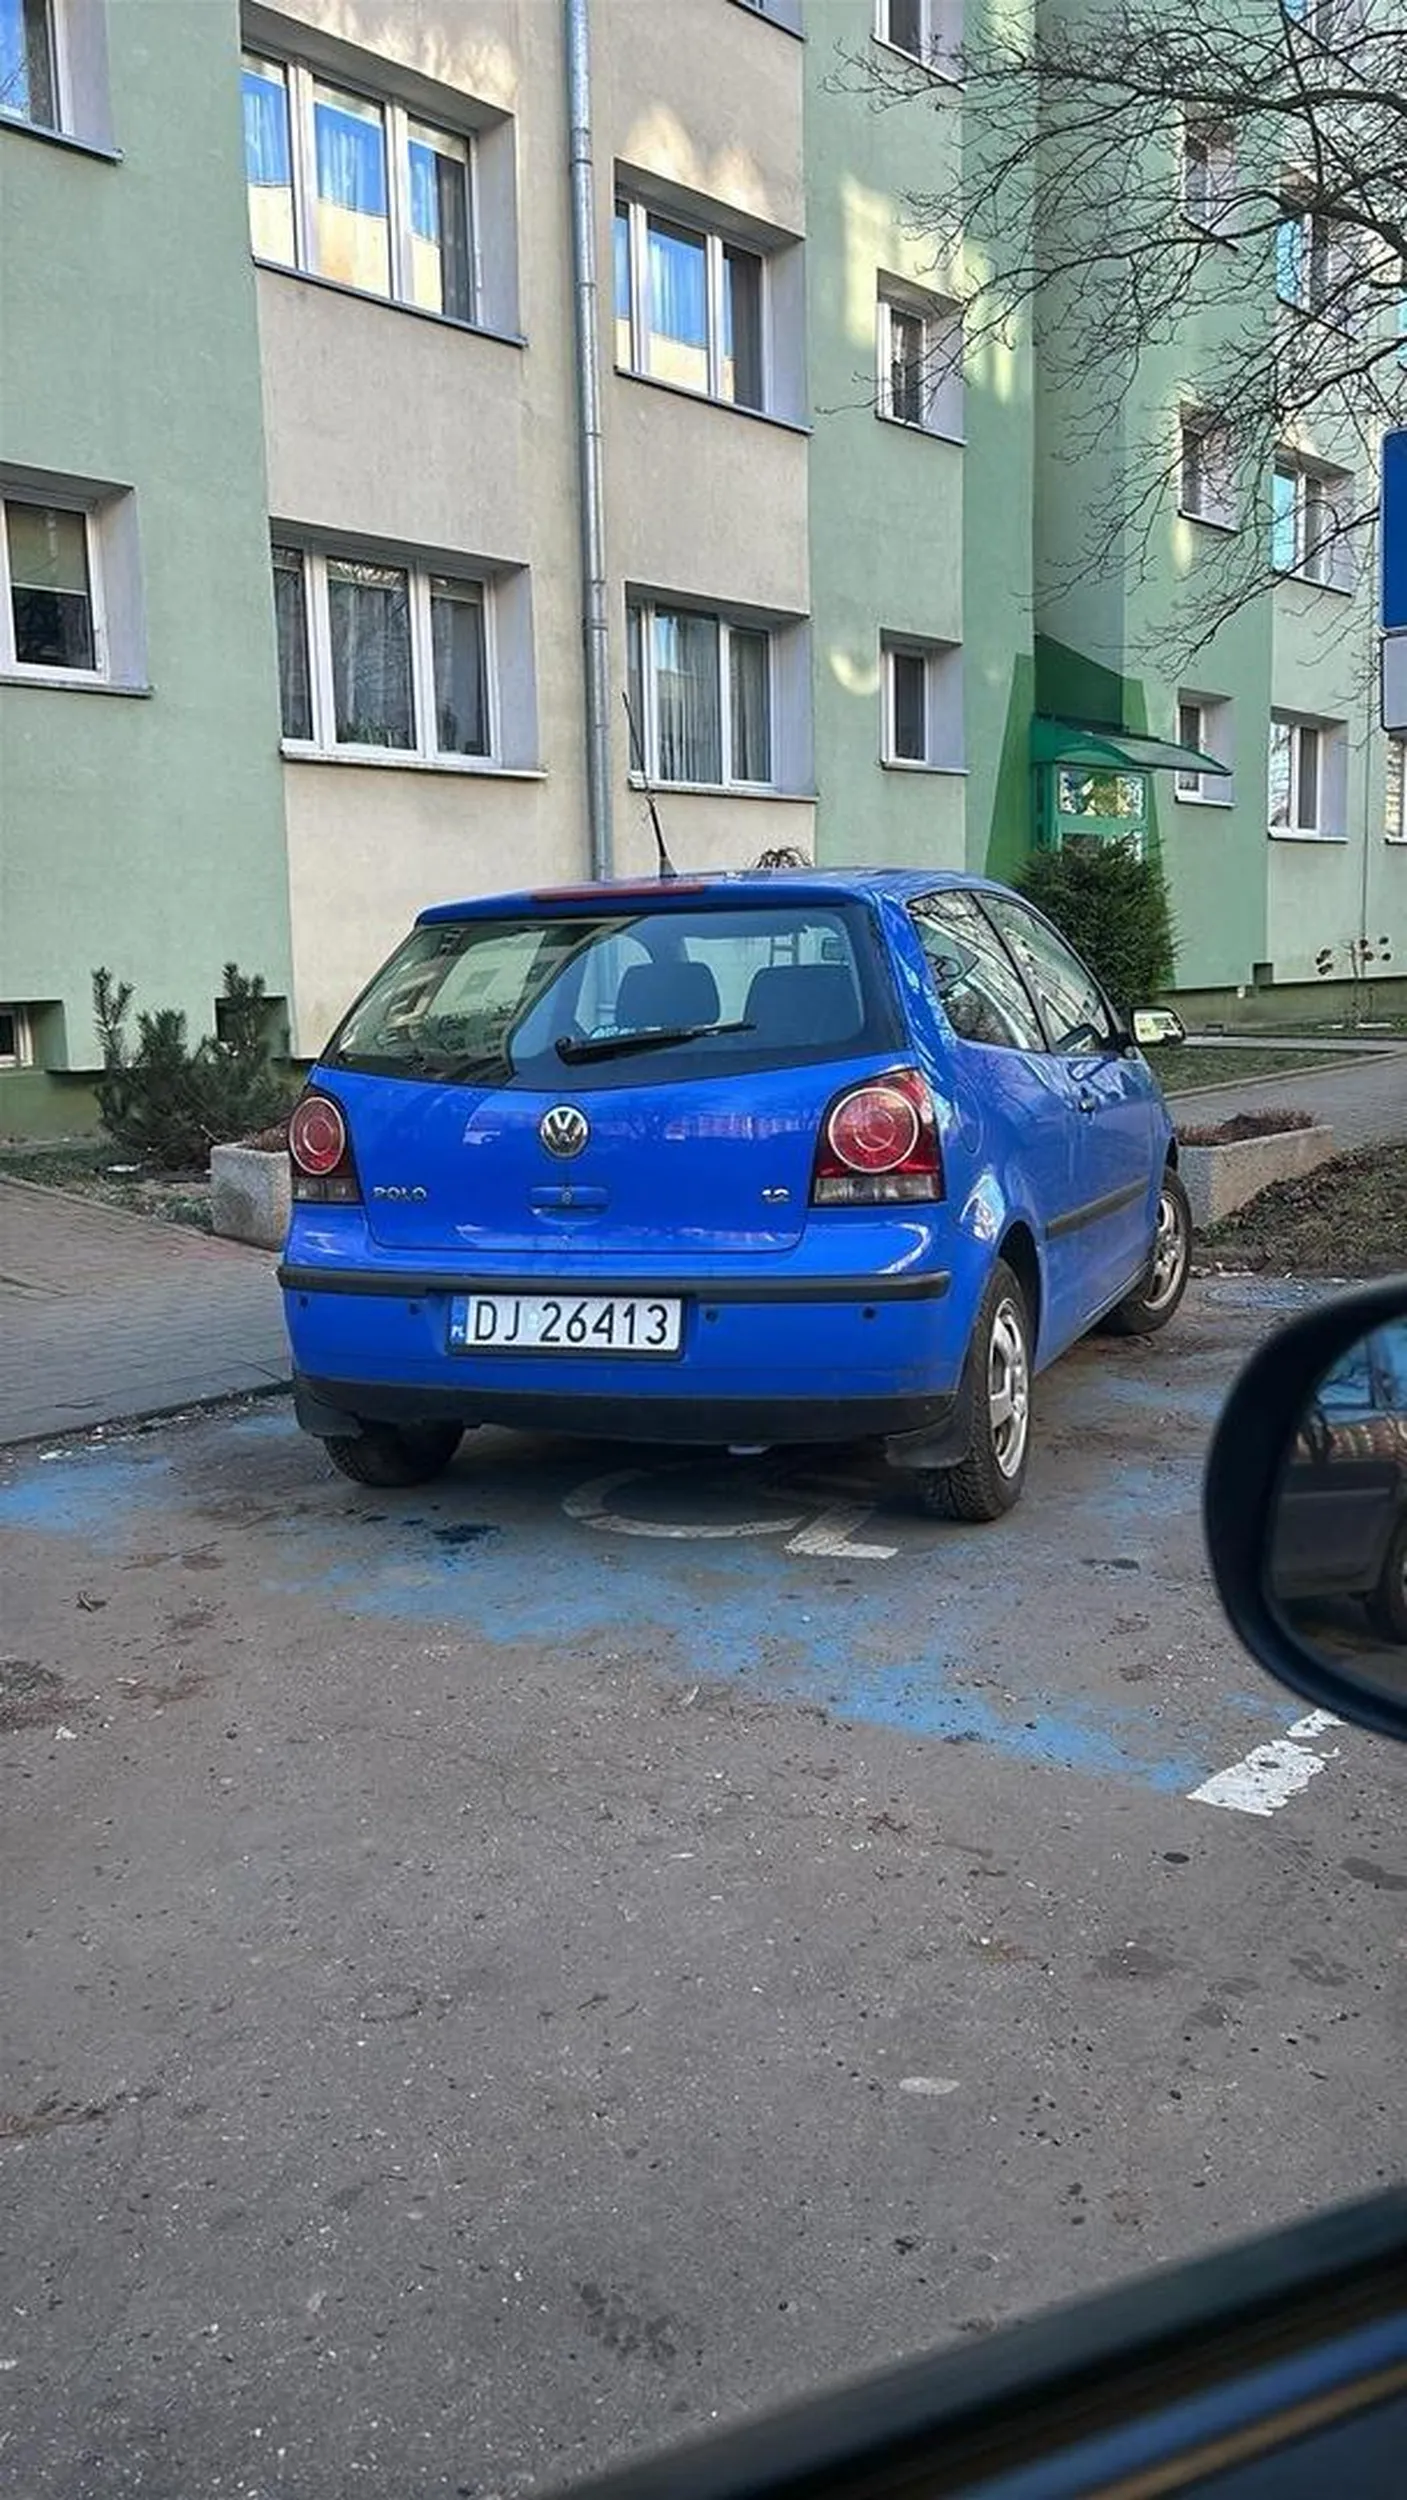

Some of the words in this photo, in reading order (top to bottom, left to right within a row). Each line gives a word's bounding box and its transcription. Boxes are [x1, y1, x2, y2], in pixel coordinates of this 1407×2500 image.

[373, 1186, 427, 1203] POLO
[474, 1300, 521, 1341] DJ
[539, 1301, 668, 1346] 26413
